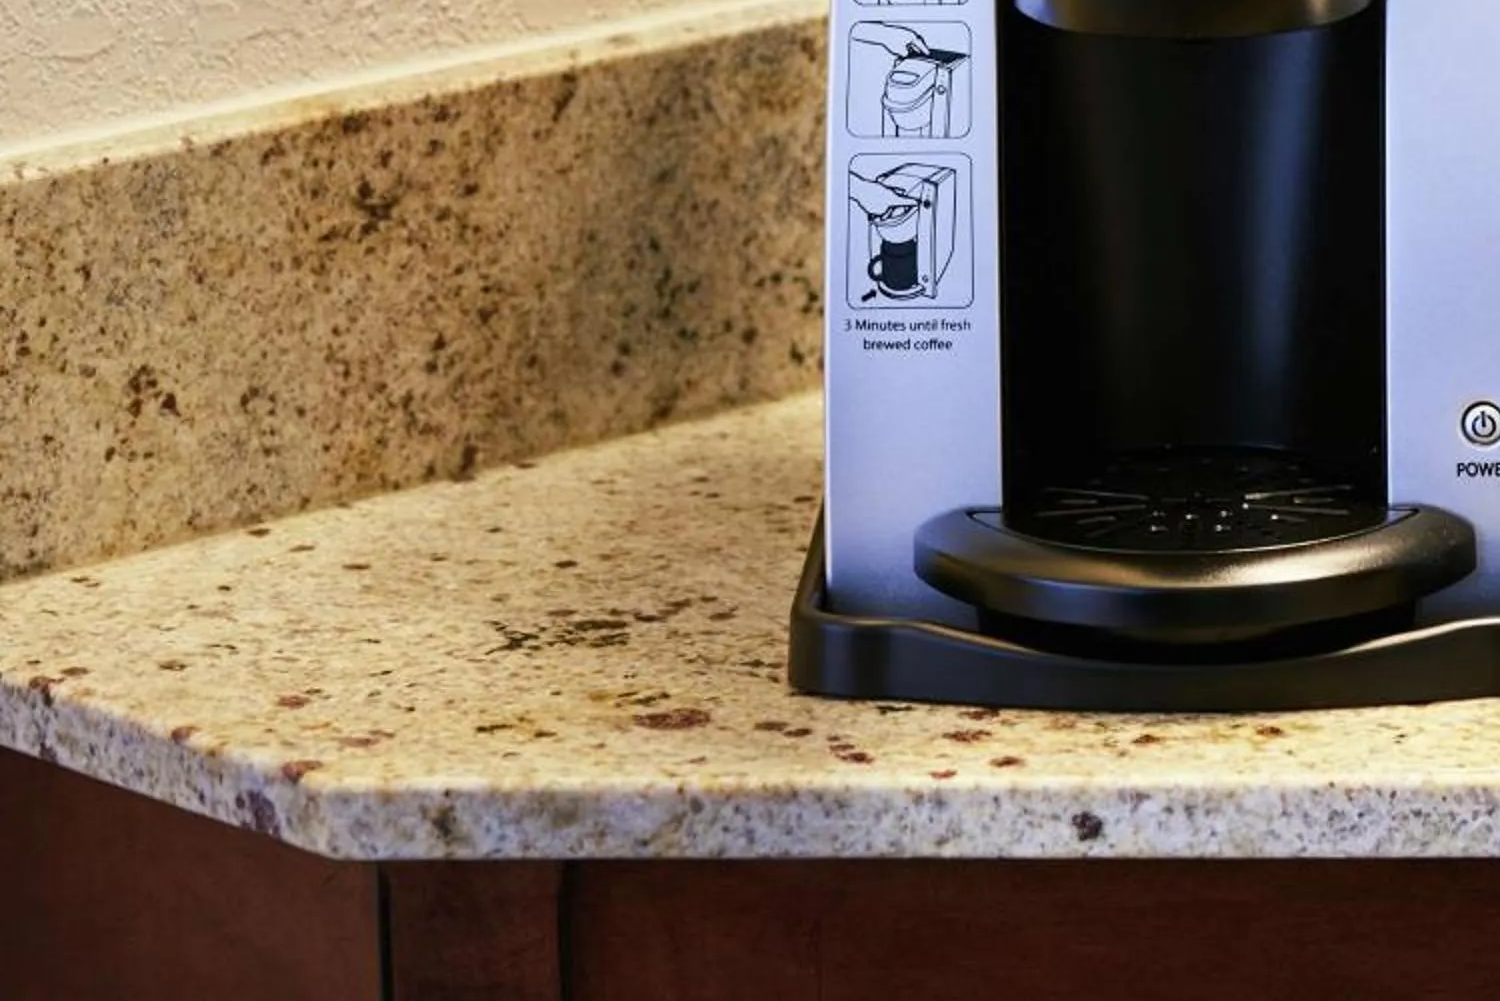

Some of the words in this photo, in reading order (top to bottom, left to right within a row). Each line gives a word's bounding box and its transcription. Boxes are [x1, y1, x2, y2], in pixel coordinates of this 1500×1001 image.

[843, 319, 852, 331] 3
[855, 319, 906, 331] Minutes
[909, 318, 938, 331] until
[940, 318, 971, 331] fresh
[863, 339, 911, 351] brewed
[913, 339, 953, 351] coffee
